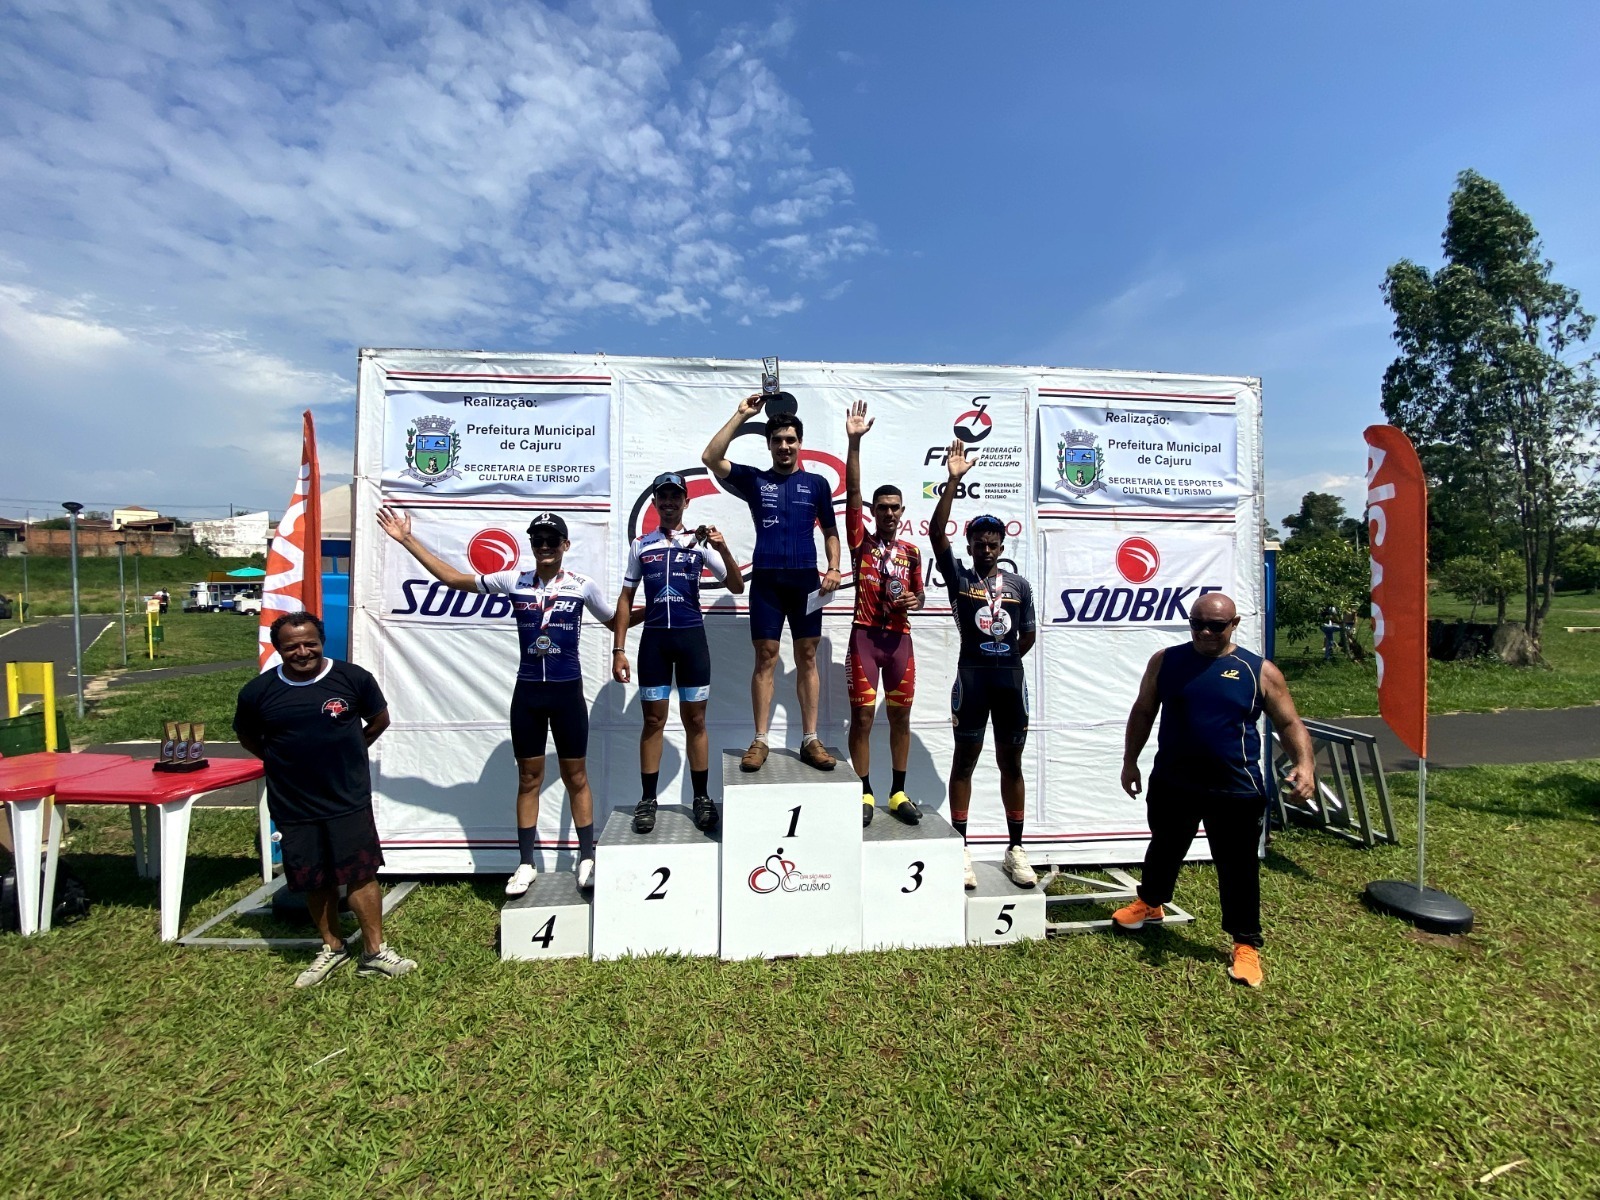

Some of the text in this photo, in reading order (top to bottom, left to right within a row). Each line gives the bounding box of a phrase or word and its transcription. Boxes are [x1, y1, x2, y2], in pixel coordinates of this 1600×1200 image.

[464, 396, 538, 410] Realização:
[1106, 412, 1170, 426] Realização:
[466, 424, 595, 438] Prefeitura Municipal
[500, 440, 562, 452] de Cajuru
[982, 446, 1022, 454] FEDERAÇÃO
[1108, 439, 1222, 454] Prefeitura Municipal
[1137, 455, 1192, 467] de Cajuru
[464, 464, 596, 473] SECRETARIA DE ESPORTES
[478, 474, 580, 483] CULTURA E TURISMO
[1108, 476, 1163, 486] SECRETARIA
[1178, 479, 1224, 487] ESPORTES
[1122, 487, 1163, 495] CULTURA
[1173, 488, 1212, 496] TURISMO
[782, 805, 802, 838] 1
[644, 867, 671, 900] 2
[900, 860, 925, 894] 3
[994, 904, 1016, 935] 5
[531, 914, 557, 948] 4
